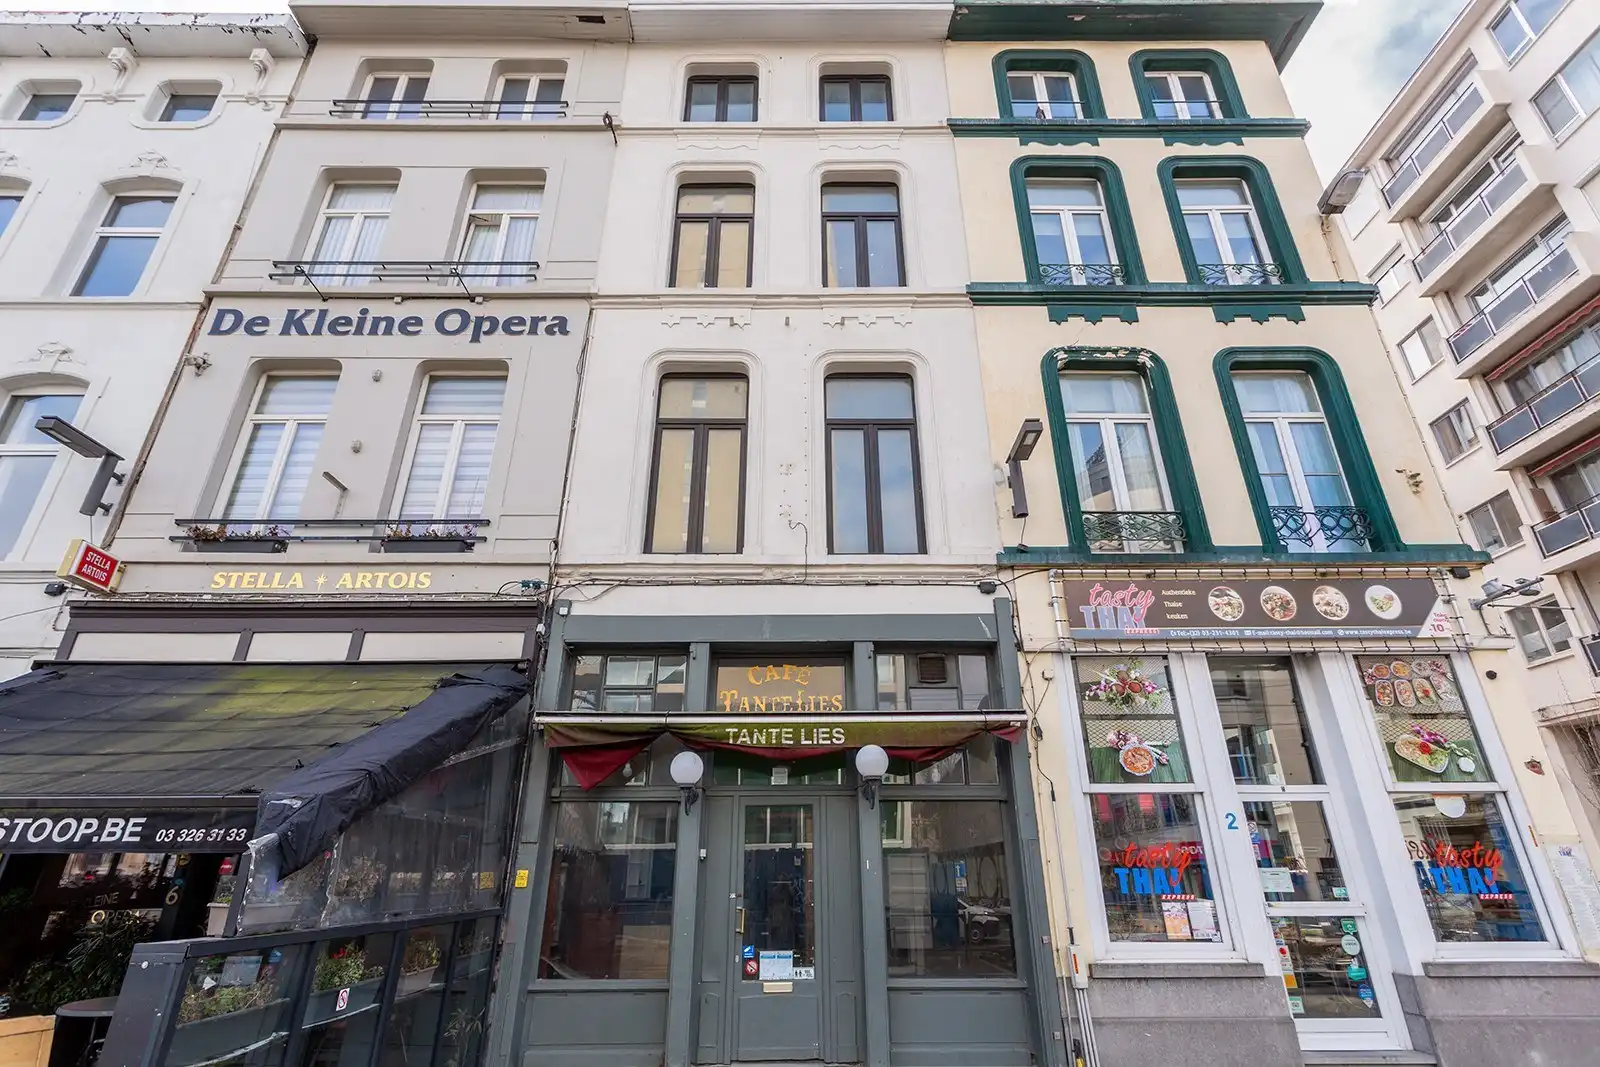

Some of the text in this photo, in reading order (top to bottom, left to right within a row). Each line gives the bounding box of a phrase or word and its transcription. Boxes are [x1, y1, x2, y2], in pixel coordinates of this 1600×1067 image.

[207, 307, 571, 343] De Kleine Opera
[86, 551, 111, 571] STELLA
[81, 563, 107, 582] ARTOIS
[210, 571, 432, 589] STELLA ARTOIS
[1089, 583, 1155, 622] tasty
[725, 727, 846, 745] TANTE LIES
[1224, 812, 1239, 830] 2
[155, 829, 173, 843] 03
[176, 828, 204, 843] 326
[206, 828, 225, 842] 31
[226, 828, 247, 842] 33
[1124, 841, 1191, 888] tasty
[1434, 840, 1503, 886] tasty
[166, 885, 179, 907] 6
[1480, 893, 1514, 901] EXPRESS
